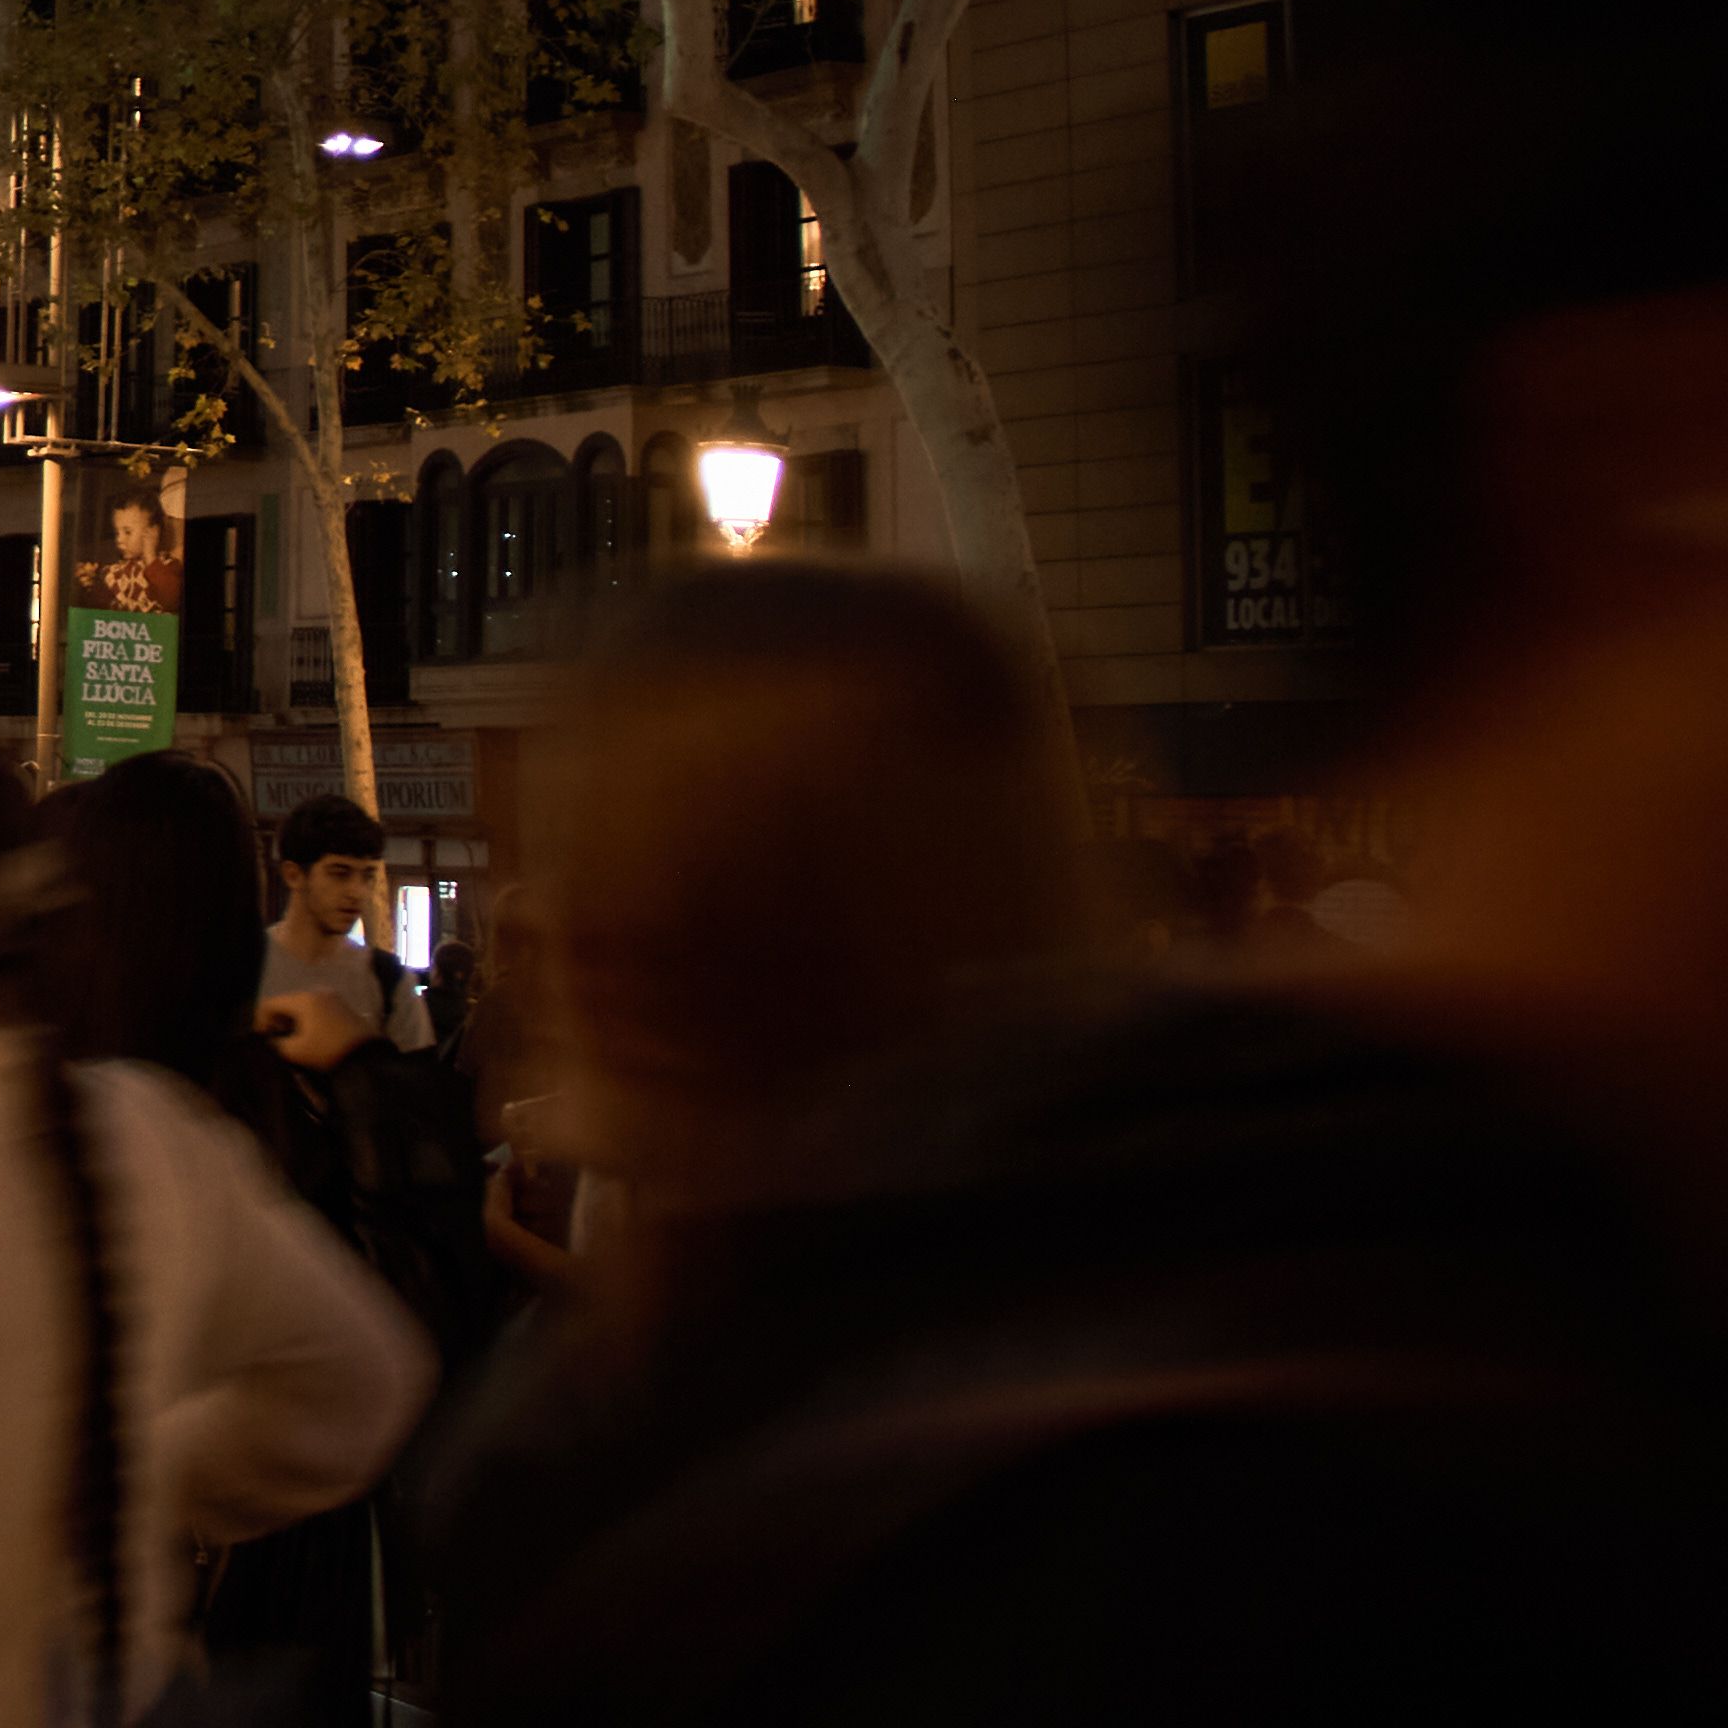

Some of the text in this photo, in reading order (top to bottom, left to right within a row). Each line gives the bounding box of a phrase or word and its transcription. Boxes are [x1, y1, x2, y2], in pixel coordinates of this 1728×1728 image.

[1225, 594, 1300, 631] LOCAL
[94, 619, 152, 642] BONA
[81, 640, 164, 663] FIRA DE
[85, 661, 155, 684] SANTA
[81, 681, 157, 706] LLÚCIA
[377, 781, 467, 810] MPORIUM
